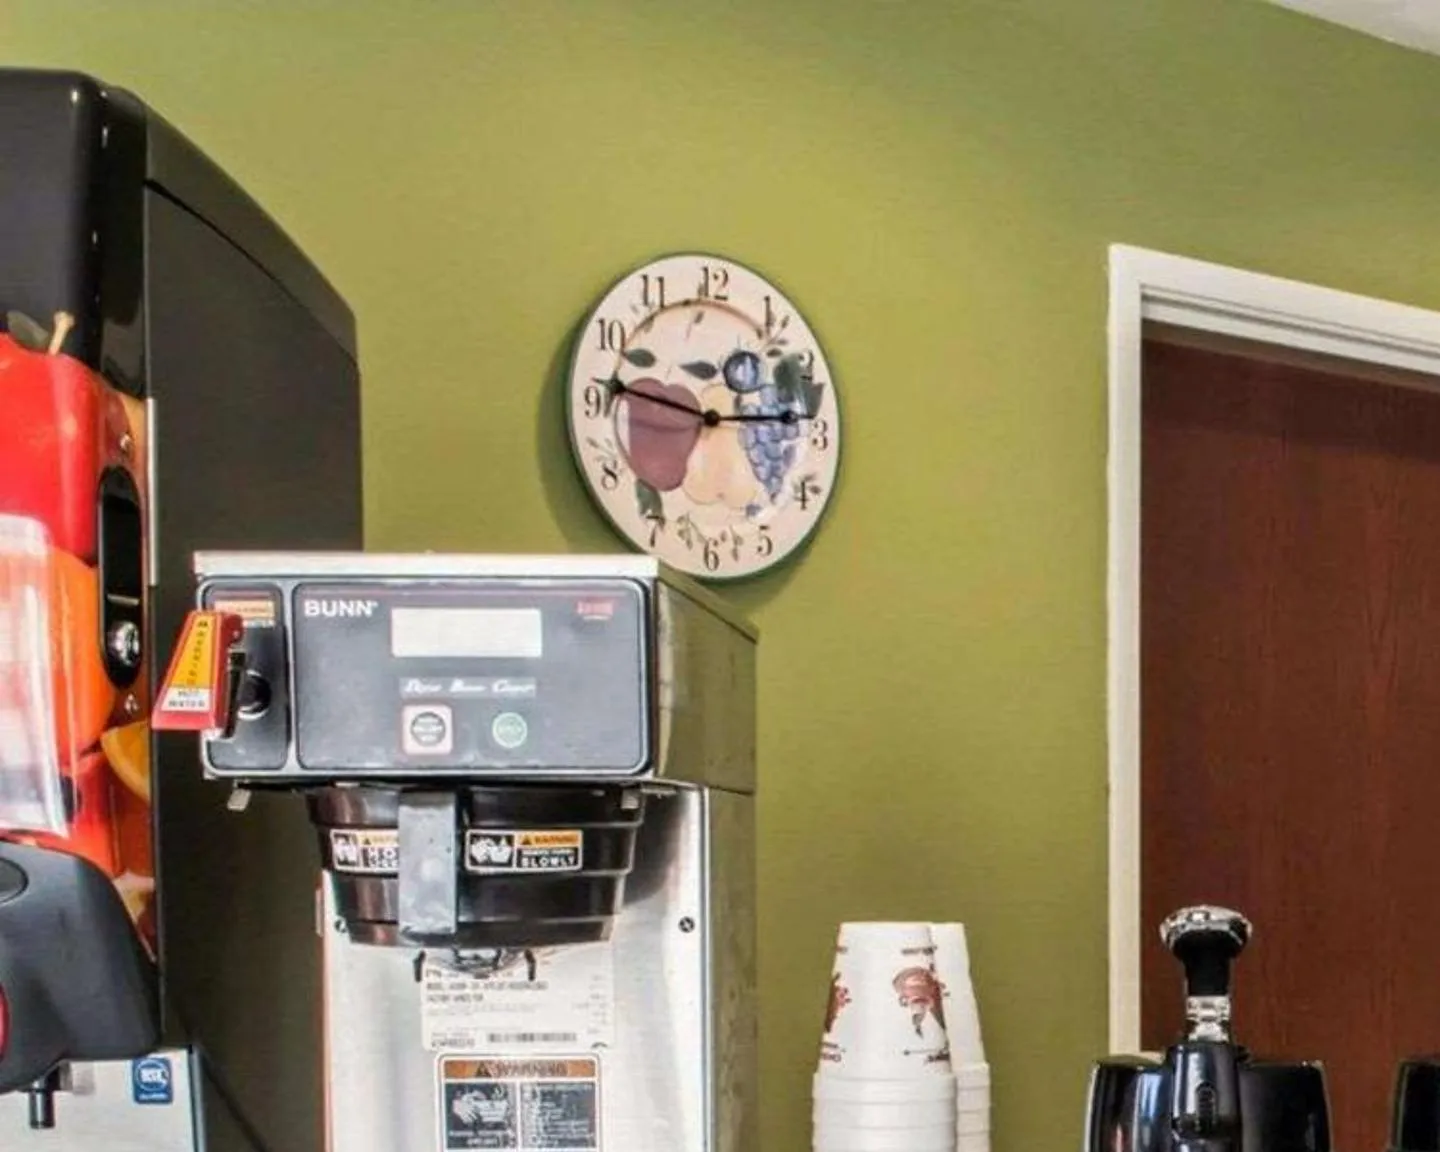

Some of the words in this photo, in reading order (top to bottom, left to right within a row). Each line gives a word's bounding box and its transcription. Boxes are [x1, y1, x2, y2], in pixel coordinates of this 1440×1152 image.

[641, 274, 665, 309] 11
[702, 266, 729, 301] 12
[597, 318, 626, 350] 10
[799, 350, 815, 381] 2
[584, 387, 601, 419] 9
[811, 419, 829, 451] 3
[601, 460, 619, 490] 8
[793, 480, 811, 510] 4
[645, 514, 665, 548] 7
[757, 525, 774, 556] 5
[703, 538, 719, 571] 6
[304, 599, 373, 617] BUNN
